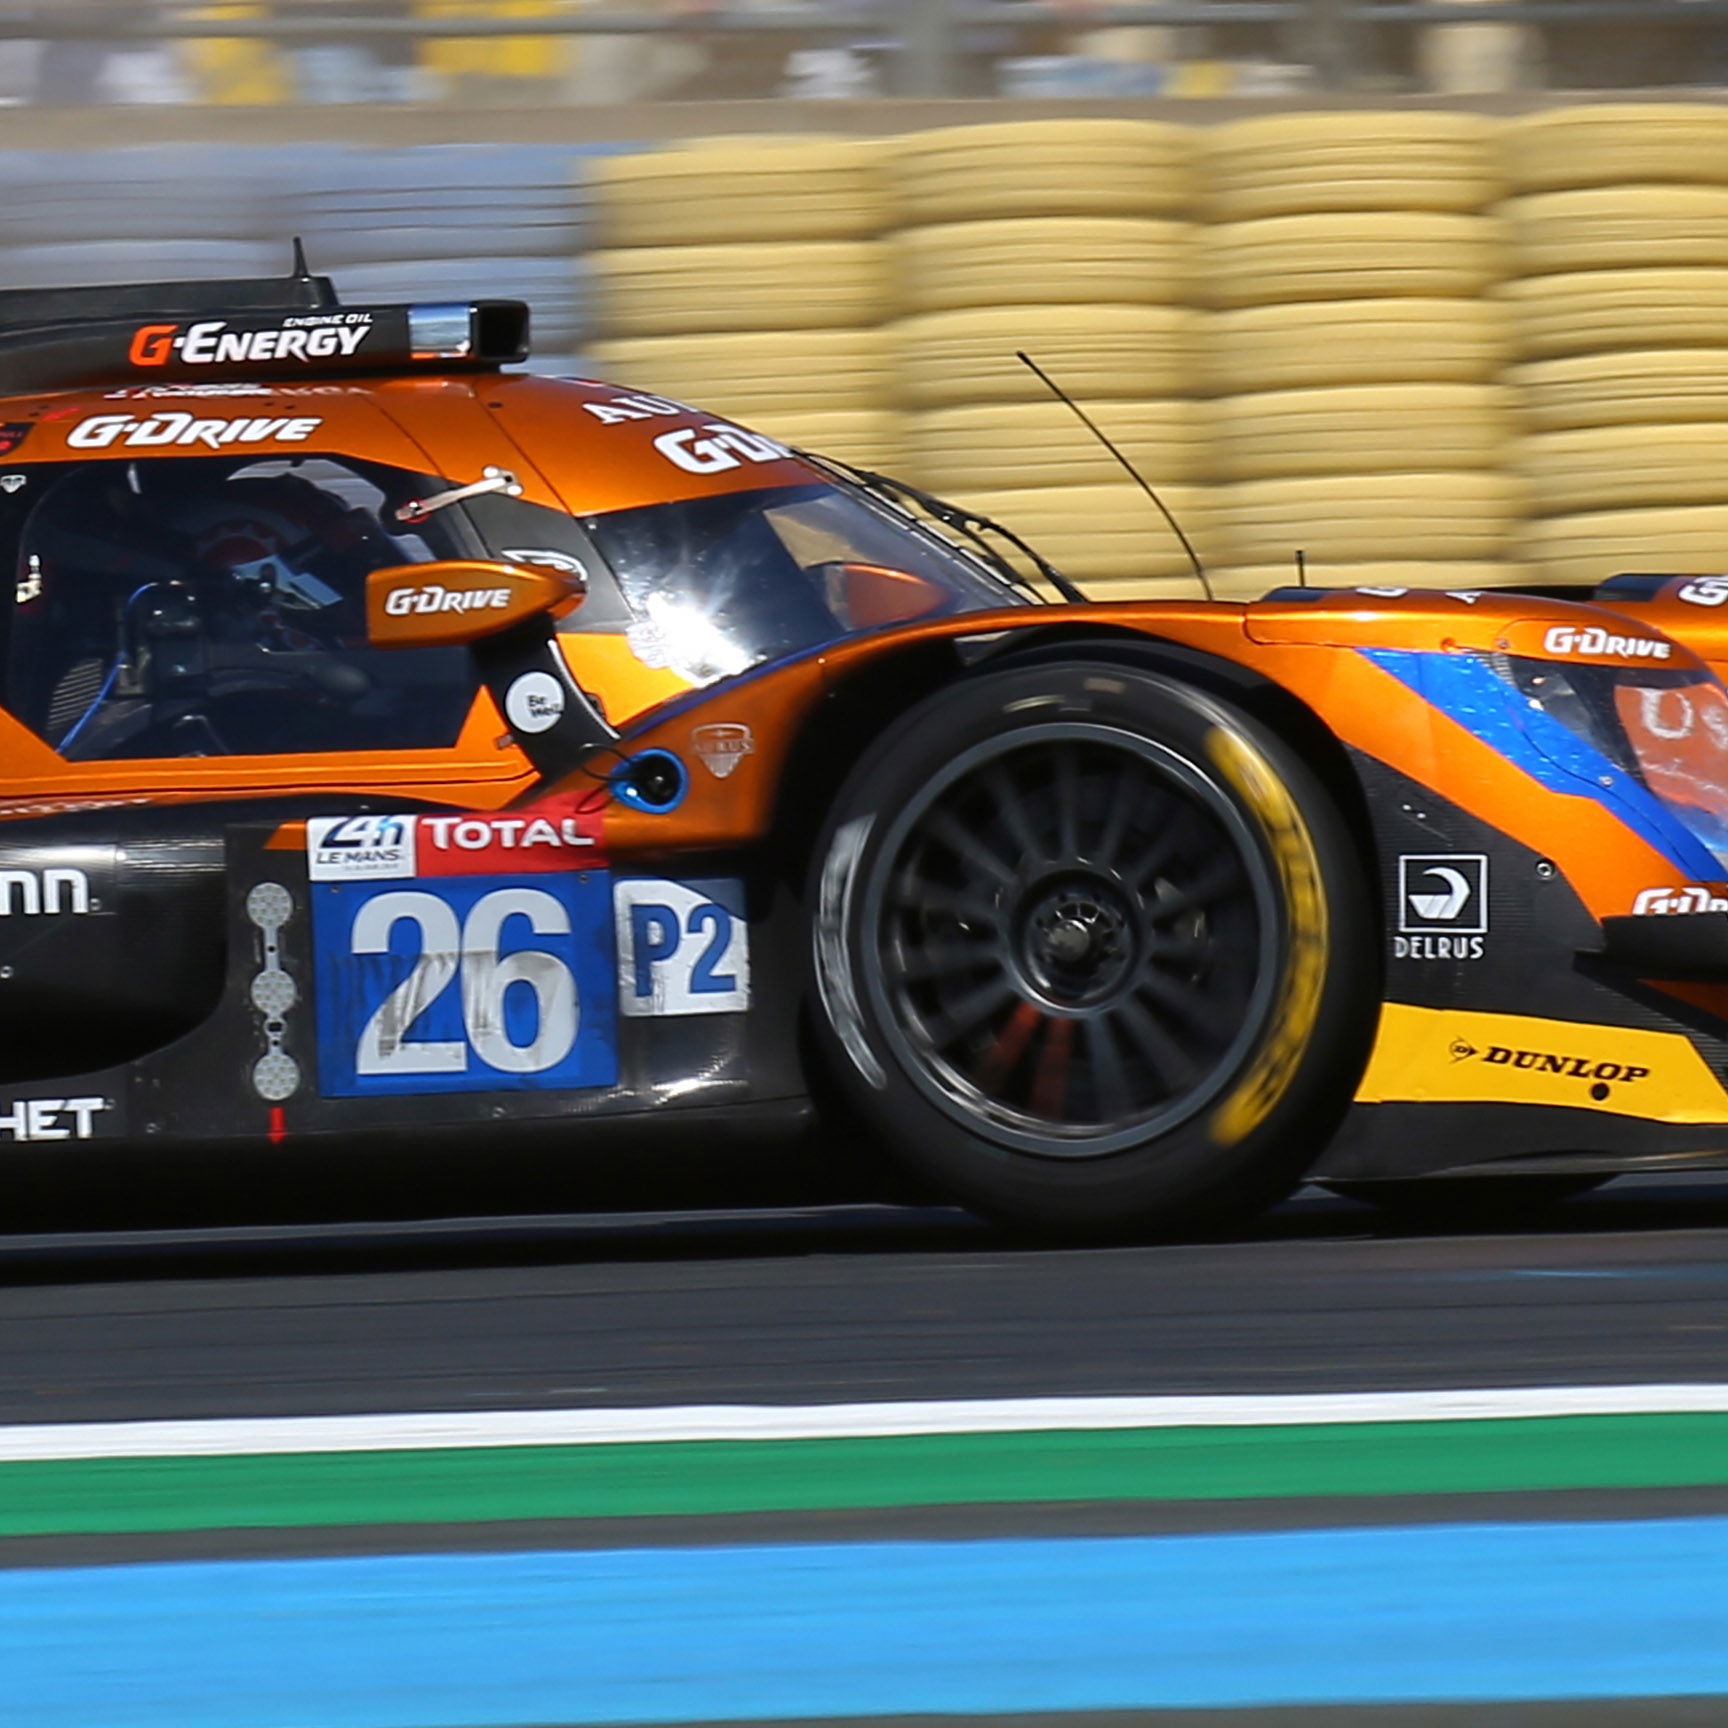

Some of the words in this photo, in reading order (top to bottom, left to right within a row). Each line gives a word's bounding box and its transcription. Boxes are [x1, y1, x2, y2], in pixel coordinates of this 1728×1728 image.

[346, 313, 373, 324] OIL
[422, 818, 594, 850] TOTAL
[316, 852, 341, 864] LE
[344, 849, 400, 862] MANS
[630, 902, 738, 998] P2
[1393, 936, 1484, 958] DELRUS
[351, 888, 580, 1075] 26
[1483, 1046, 1650, 1082] DUNLOP
